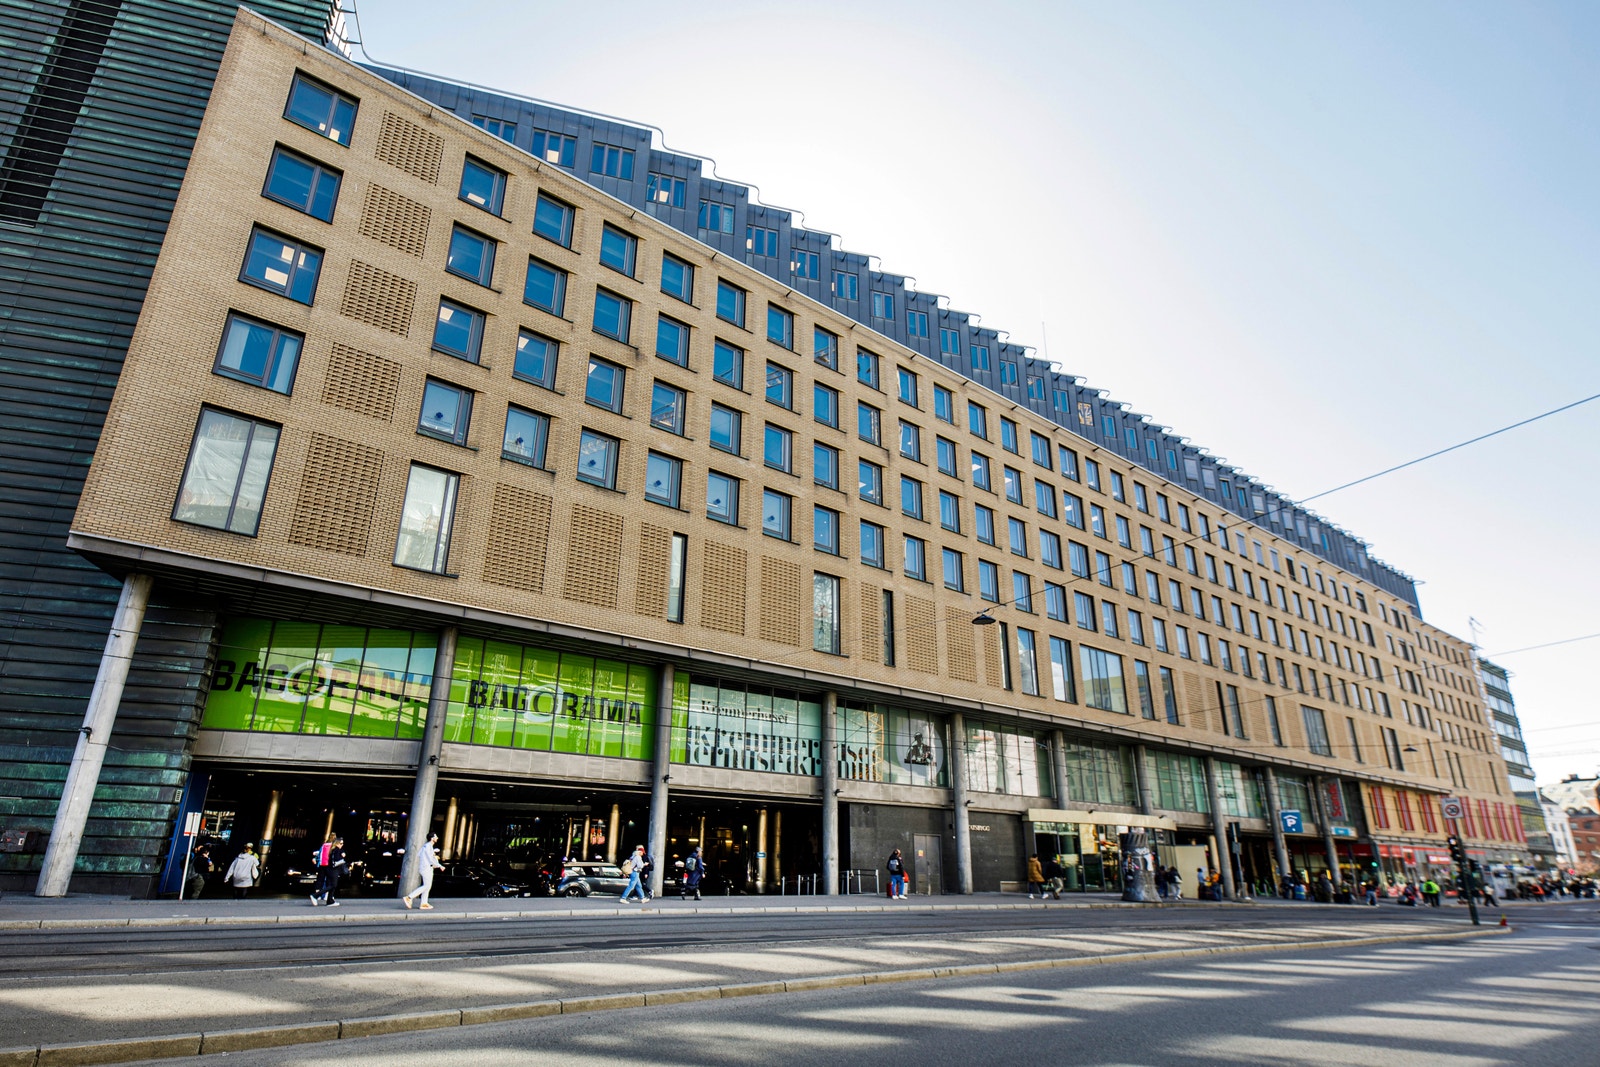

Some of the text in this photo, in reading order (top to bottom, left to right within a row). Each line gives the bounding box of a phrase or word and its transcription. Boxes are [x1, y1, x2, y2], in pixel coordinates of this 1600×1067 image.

[210, 659, 431, 703] BAGORAMA
[467, 679, 642, 727] BAGORAMA
[701, 700, 788, 723] Kremmerhuset
